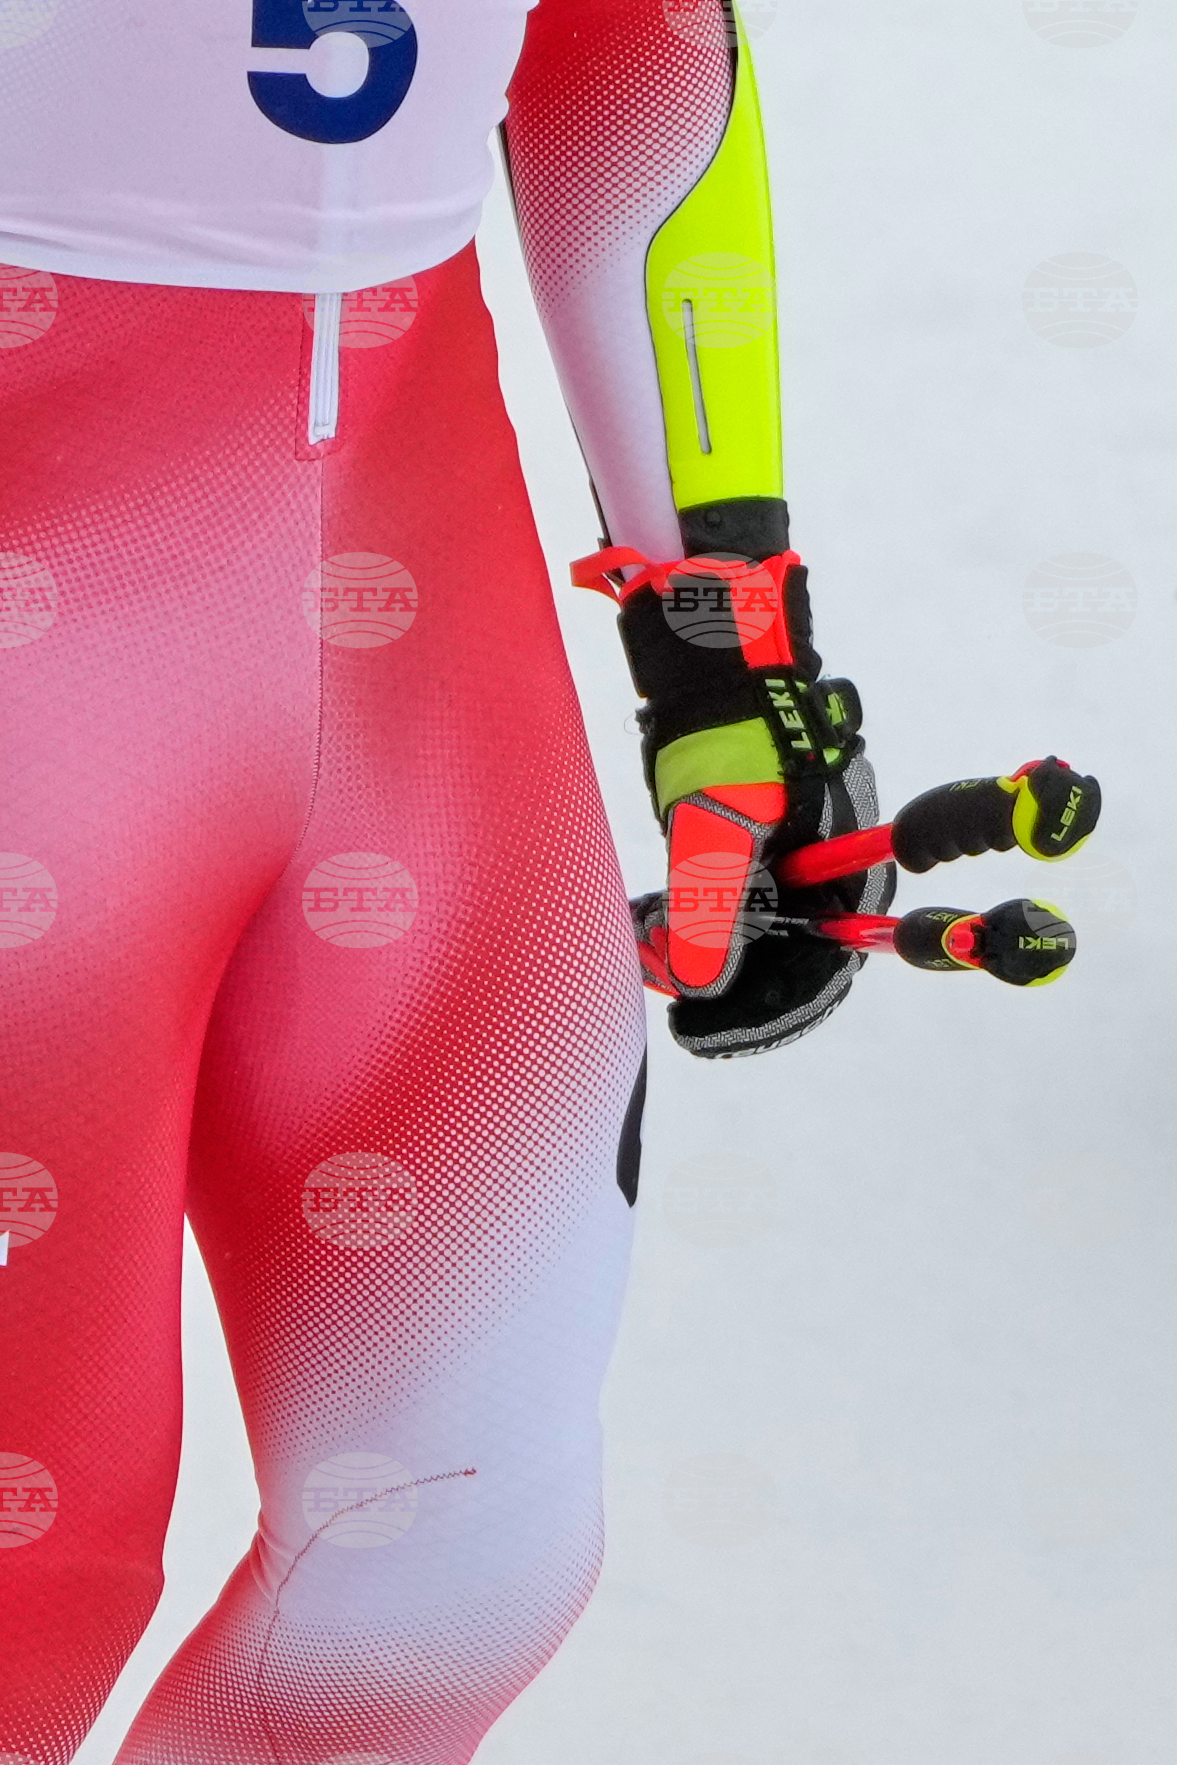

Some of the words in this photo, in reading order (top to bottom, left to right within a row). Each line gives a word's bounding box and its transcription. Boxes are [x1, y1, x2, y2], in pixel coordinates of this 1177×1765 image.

[764, 678, 813, 750] LEKI
[1050, 785, 1083, 842] LEKI
[1018, 936, 1069, 950] LEKI
